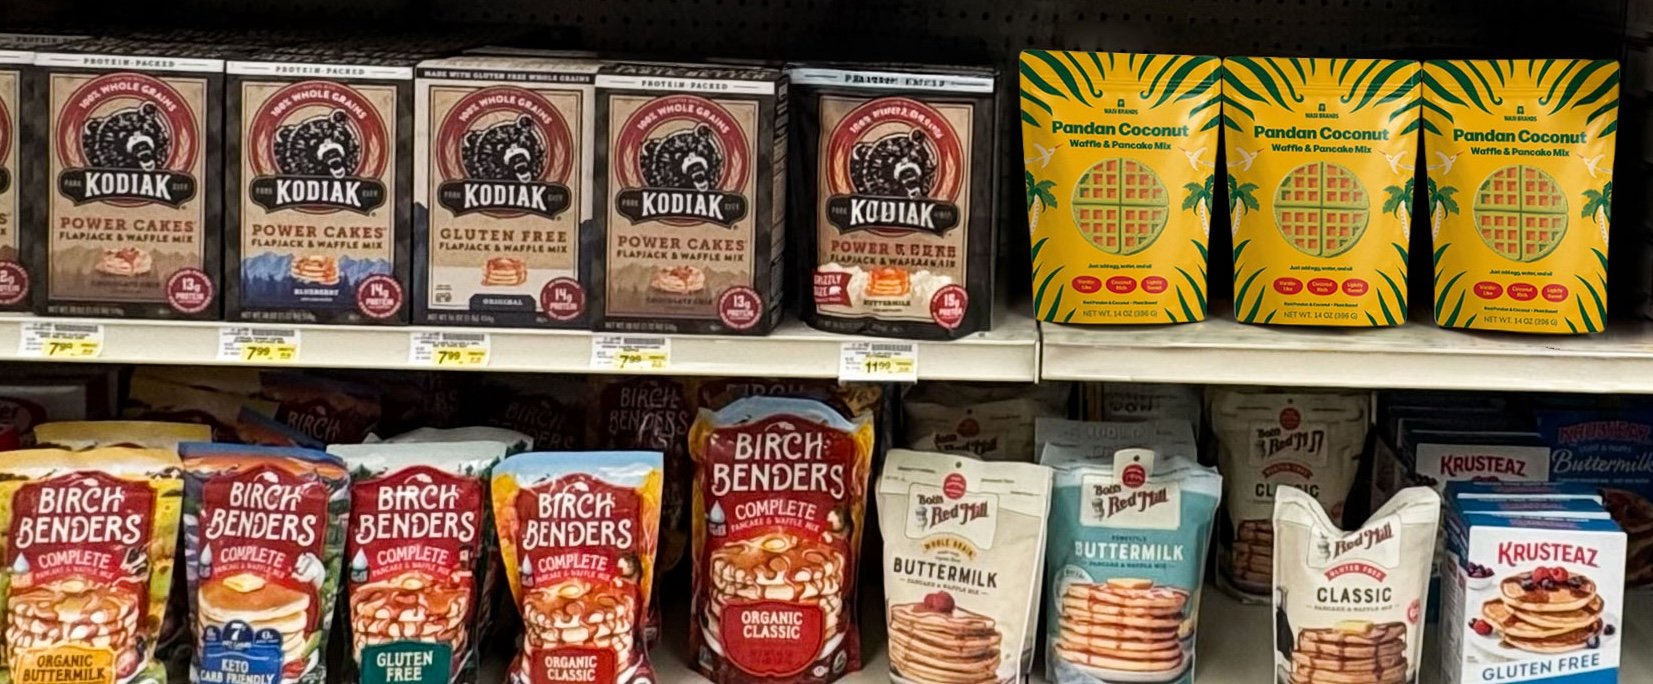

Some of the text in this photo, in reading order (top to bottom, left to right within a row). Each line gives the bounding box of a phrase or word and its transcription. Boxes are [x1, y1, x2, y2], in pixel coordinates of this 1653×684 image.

[473, 72, 505, 80] GLUTEN
[79, 82, 177, 112] 100% WHOLE GRAINS
[271, 90, 367, 120] 100% WHOLE GRAINS
[459, 95, 553, 125] 100% WHOLE GRAINS
[637, 104, 731, 134] 100% WHOLE GRAINS
[1052, 121, 1189, 137] Pandan Coconut
[1254, 125, 1389, 141] Pandan Coconut
[1453, 128, 1587, 144] Pandan Coconut
[1070, 139, 1102, 148] Waffle
[1112, 140, 1153, 150] Pancake
[1154, 142, 1171, 150] Mix
[1271, 143, 1372, 154] Waffle & Pancake Mix
[1470, 146, 1570, 158] Waffle & Pancake Mix
[85, 172, 172, 200] KODIAK
[276, 179, 361, 207] KODIAK
[464, 184, 546, 211] KODIAK
[642, 192, 724, 220] KODIAK
[60, 217, 194, 232] POWER CAKES
[252, 225, 383, 239] POWER CAKES
[60, 231, 194, 243] FLAPJACK & WAFFLE MIX
[251, 239, 304, 248] FLAPJACK
[317, 241, 358, 249] WAFFLE
[362, 242, 383, 250] MIX
[440, 228, 567, 243] GLUTEN FREE
[617, 235, 745, 251] POWER CAKES
[439, 242, 490, 251] FLAPJACK
[504, 244, 544, 252] WAFFLE
[547, 245, 567, 253] MIX
[617, 249, 667, 259] FLAPJACK
[681, 252, 721, 261] WAFFLE
[182, 278, 201, 293] 13g
[370, 284, 389, 298] 14g
[555, 288, 572, 301] 14g
[733, 295, 751, 309] 13g
[735, 432, 824, 460] BIRCH
[1441, 454, 1527, 477] KRUSTEAZ
[1552, 448, 1653, 474] Buttermilk
[711, 463, 845, 499] BENDERS
[38, 486, 125, 514] BIRCH
[229, 482, 301, 511] BIRCH
[378, 484, 459, 511] BIRCH
[538, 493, 615, 519] BIRCH
[735, 499, 818, 521] COMPLETE
[1108, 497, 1136, 518] Red
[930, 504, 958, 528] Red
[15, 514, 143, 549] BENDERS
[205, 509, 317, 547] BENDERS
[355, 511, 475, 545] BENDERS
[522, 520, 632, 551] BENDERS
[1364, 523, 1394, 550] Mill
[220, 545, 285, 567] COMPLETE
[377, 544, 449, 566] COMPLETE
[1075, 541, 1183, 560] BUTTERMILK
[1498, 541, 1600, 568] KRUSTEAZ
[38, 550, 112, 570] COMPLETE
[538, 554, 608, 572] COMPLETE
[893, 557, 998, 588] BUTTERMILK
[1316, 587, 1392, 603] CLASSIC
[742, 611, 803, 625] ORGANIC
[743, 624, 801, 639] CLASSIC
[37, 654, 93, 668] ORGANIC
[221, 658, 249, 673] KETO
[376, 651, 433, 667] GLUTEN
[545, 656, 597, 668] ORGANIC
[1482, 653, 1600, 682] GLUTEN FREE
[22, 667, 106, 682] BUTTERMILK
[200, 669, 274, 684] CARB FRIENDLY
[386, 666, 422, 682] FREE
[547, 668, 595, 681] CLASSIC
